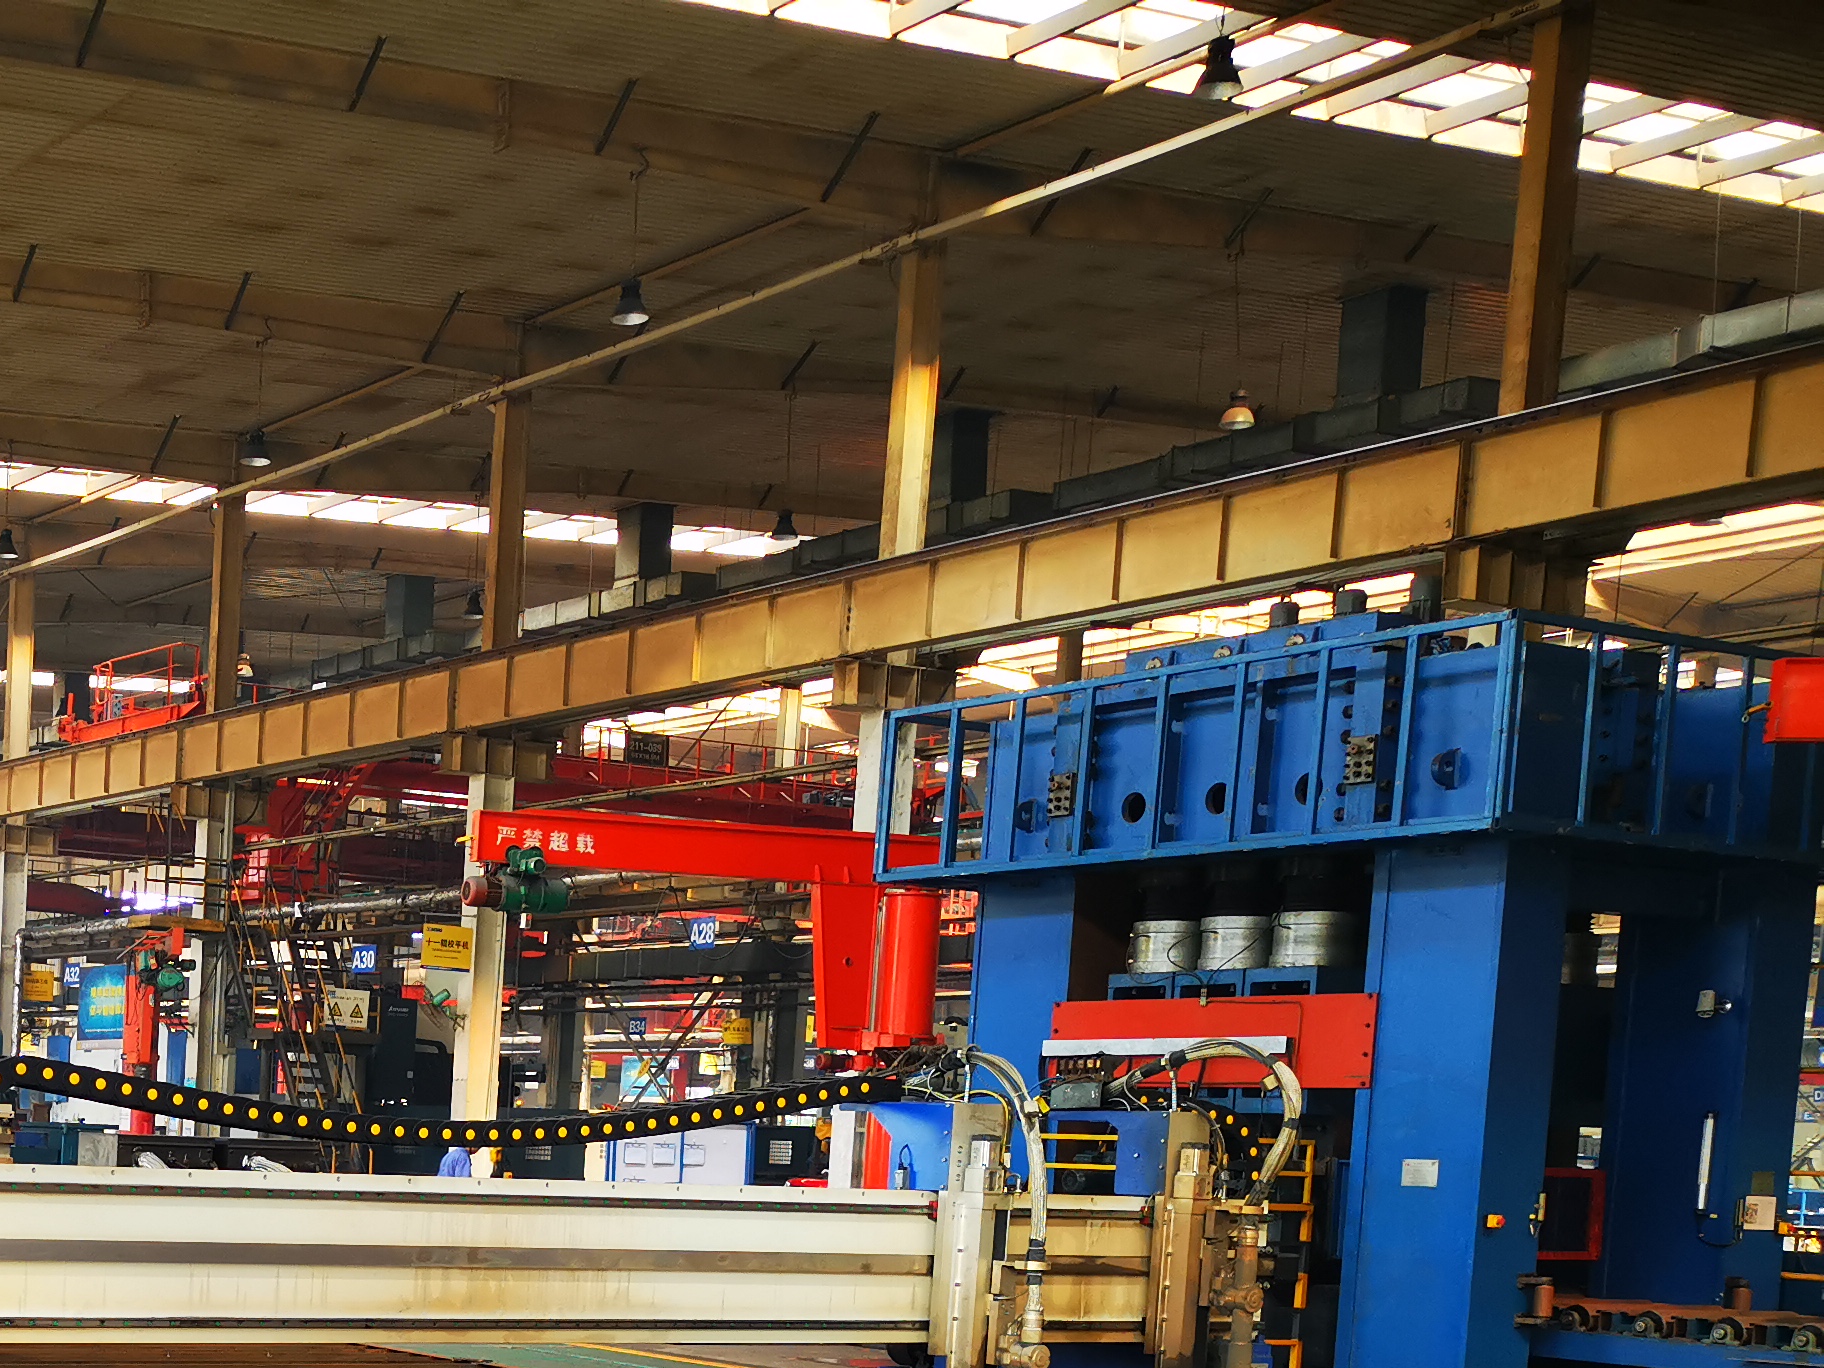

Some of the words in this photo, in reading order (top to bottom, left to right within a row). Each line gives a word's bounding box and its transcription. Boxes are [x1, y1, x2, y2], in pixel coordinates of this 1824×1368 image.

[497, 826, 595, 855] 严禁超载
[691, 922, 714, 944] A28
[352, 950, 375, 969] A30
[64, 967, 80, 983] A32
[629, 1021, 646, 1033] B34
